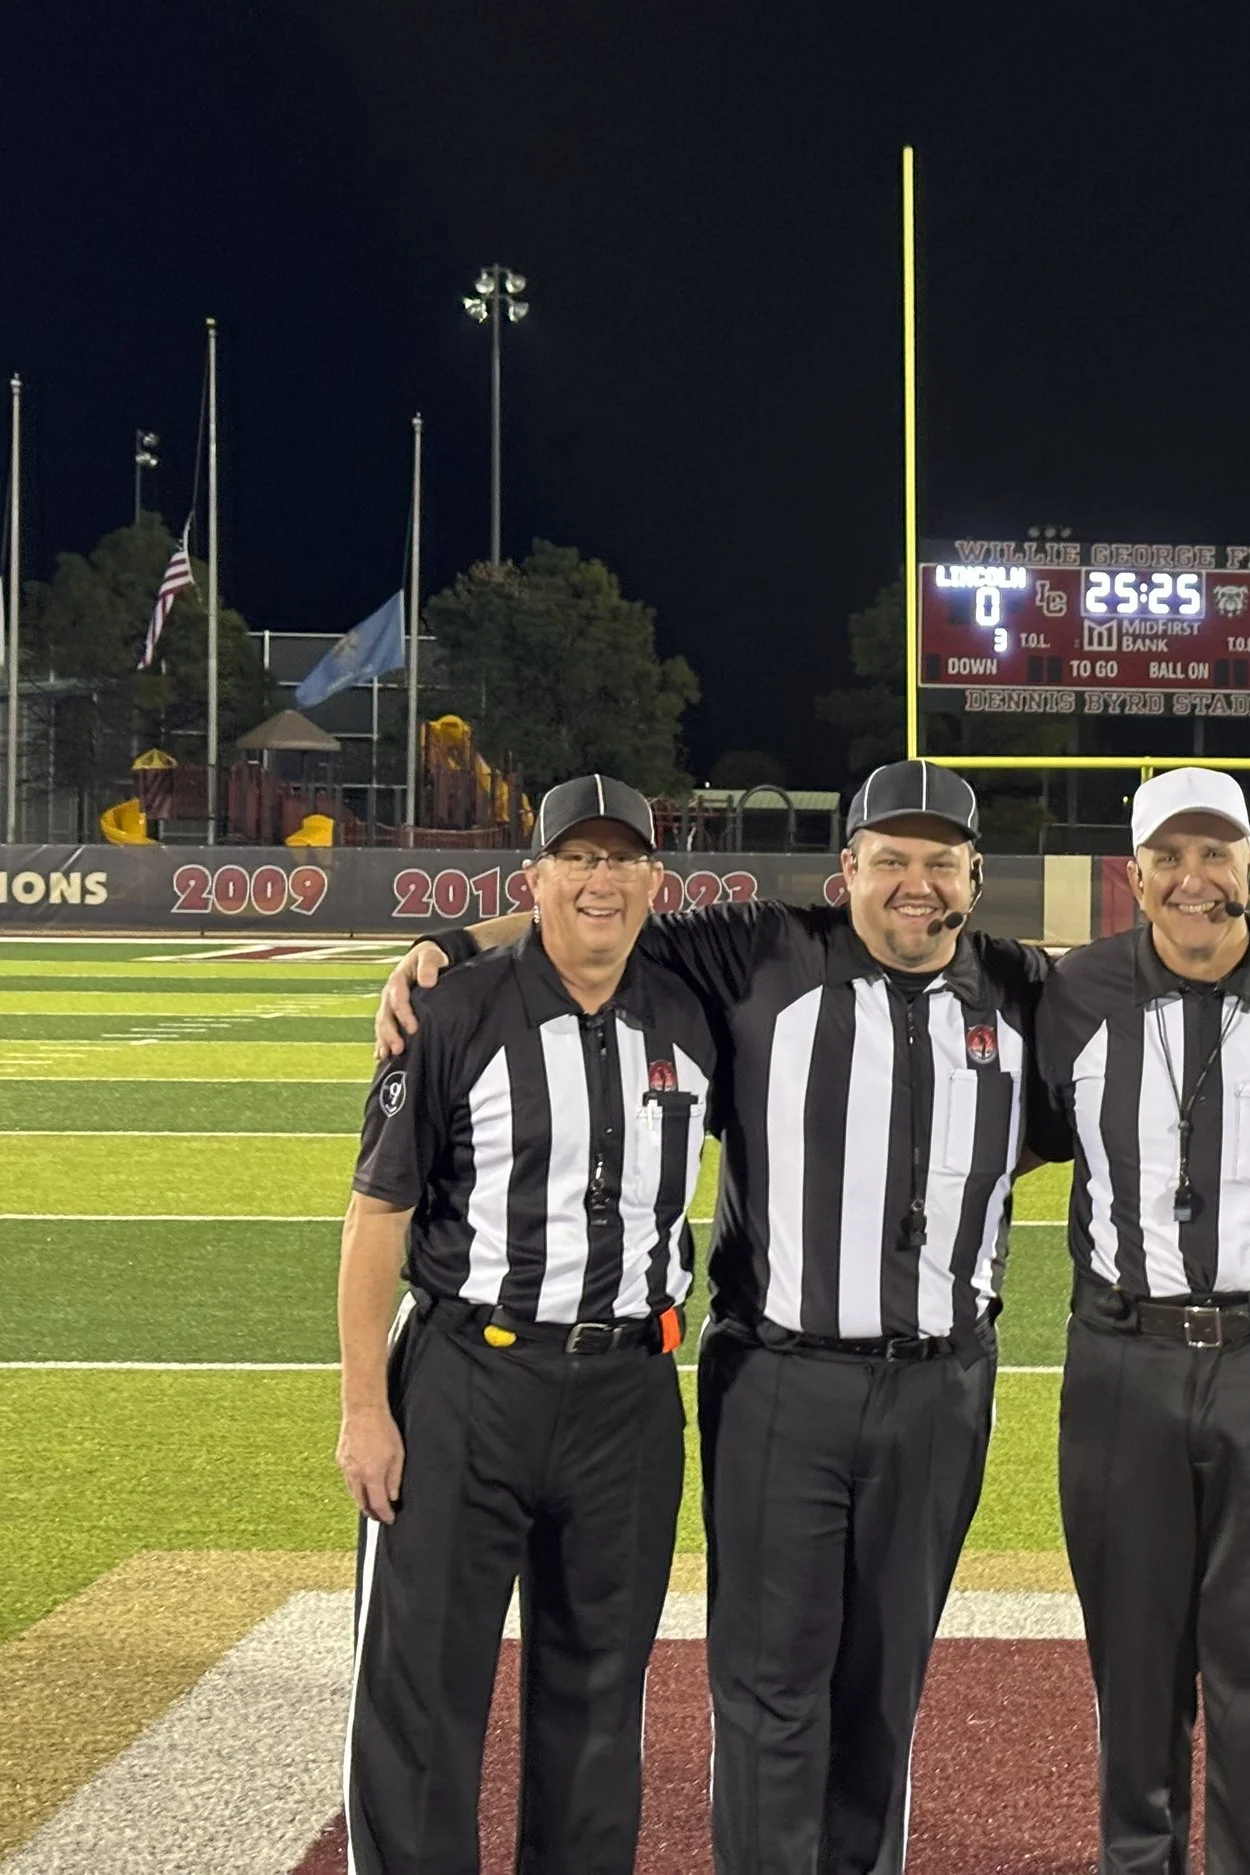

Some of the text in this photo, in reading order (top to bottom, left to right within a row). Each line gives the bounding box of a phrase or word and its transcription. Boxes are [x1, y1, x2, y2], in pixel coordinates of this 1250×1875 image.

[954, 540, 1081, 566] WILLIE
[1091, 543, 1216, 569] GEORGE
[936, 565, 1027, 589] LINCOLN
[1085, 571, 1201, 615] 25:25
[975, 586, 1001, 627] 0
[993, 627, 1008, 653] 3
[947, 657, 998, 675] DOWN
[1069, 660, 1118, 678] TO GO
[1149, 661, 1209, 680] BALL ON
[965, 689, 1076, 713] DENNIS
[1084, 691, 1165, 715] BYRD
[170, 864, 328, 916] 2009
